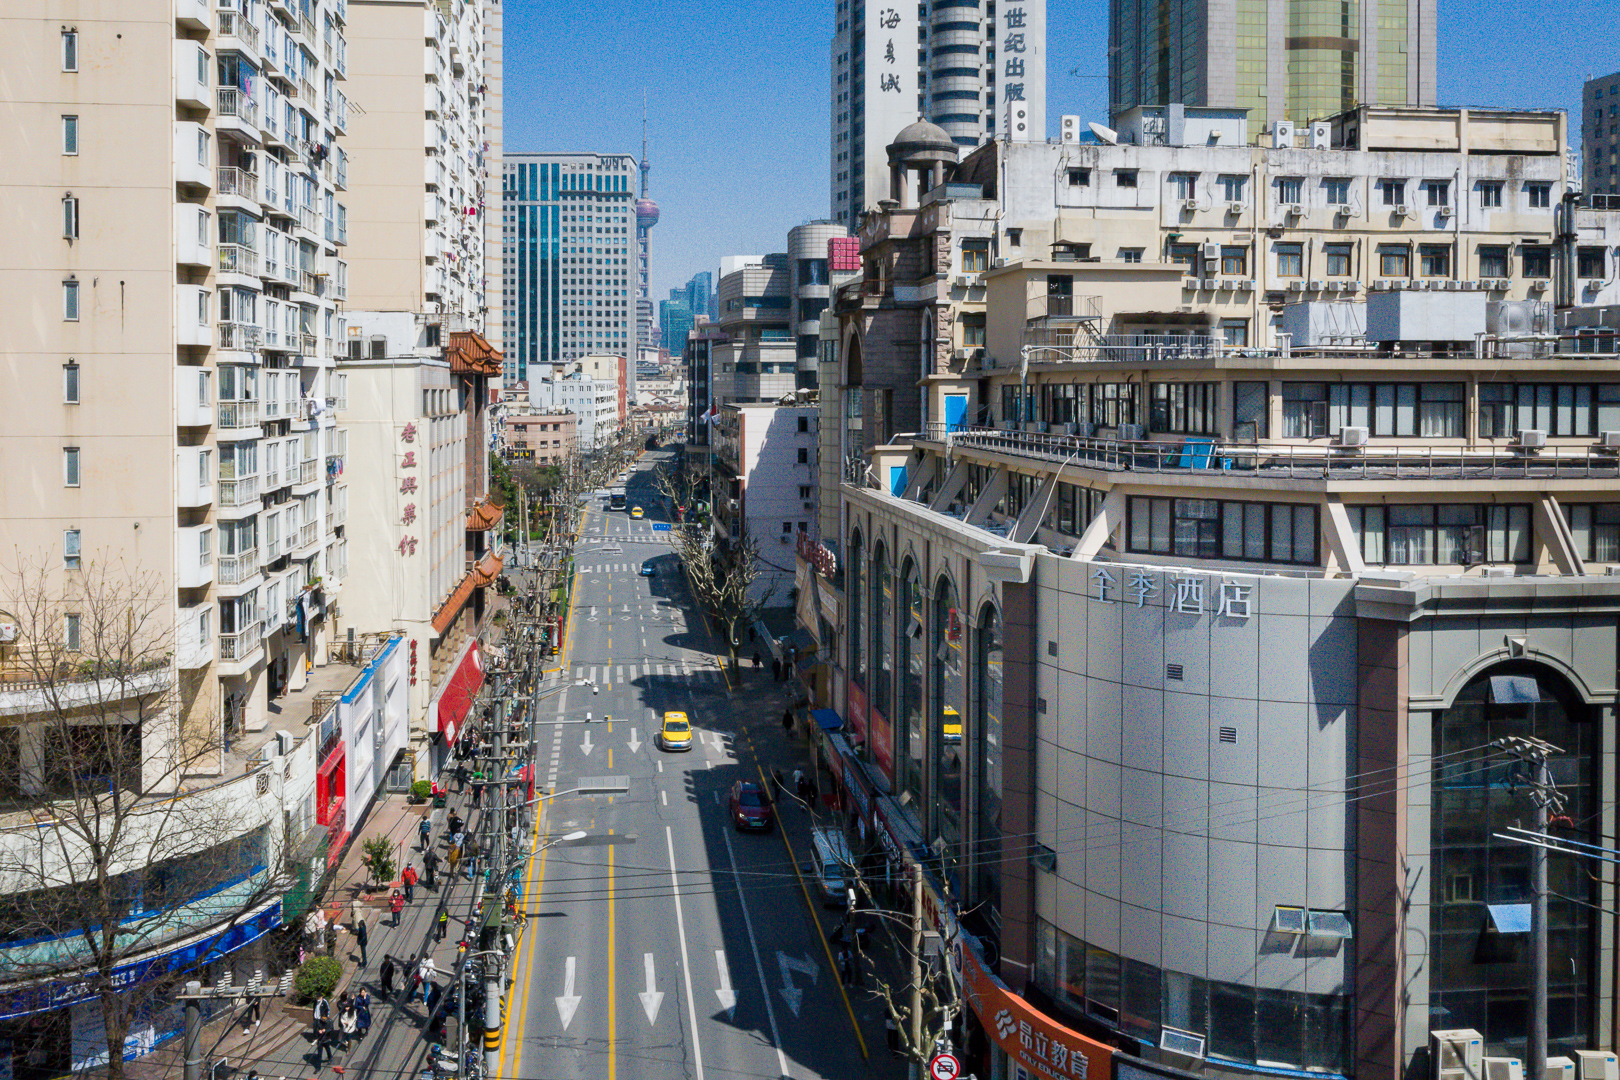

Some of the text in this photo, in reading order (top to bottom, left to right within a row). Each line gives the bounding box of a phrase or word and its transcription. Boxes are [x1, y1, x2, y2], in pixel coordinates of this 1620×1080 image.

[1003, 0, 1027, 130] 世纪出版
[1090, 568, 1253, 617] 全季酒店
[1019, 1020, 1089, 1080] 昂立教育
[1038, 1063, 1073, 1080] EDUCA
